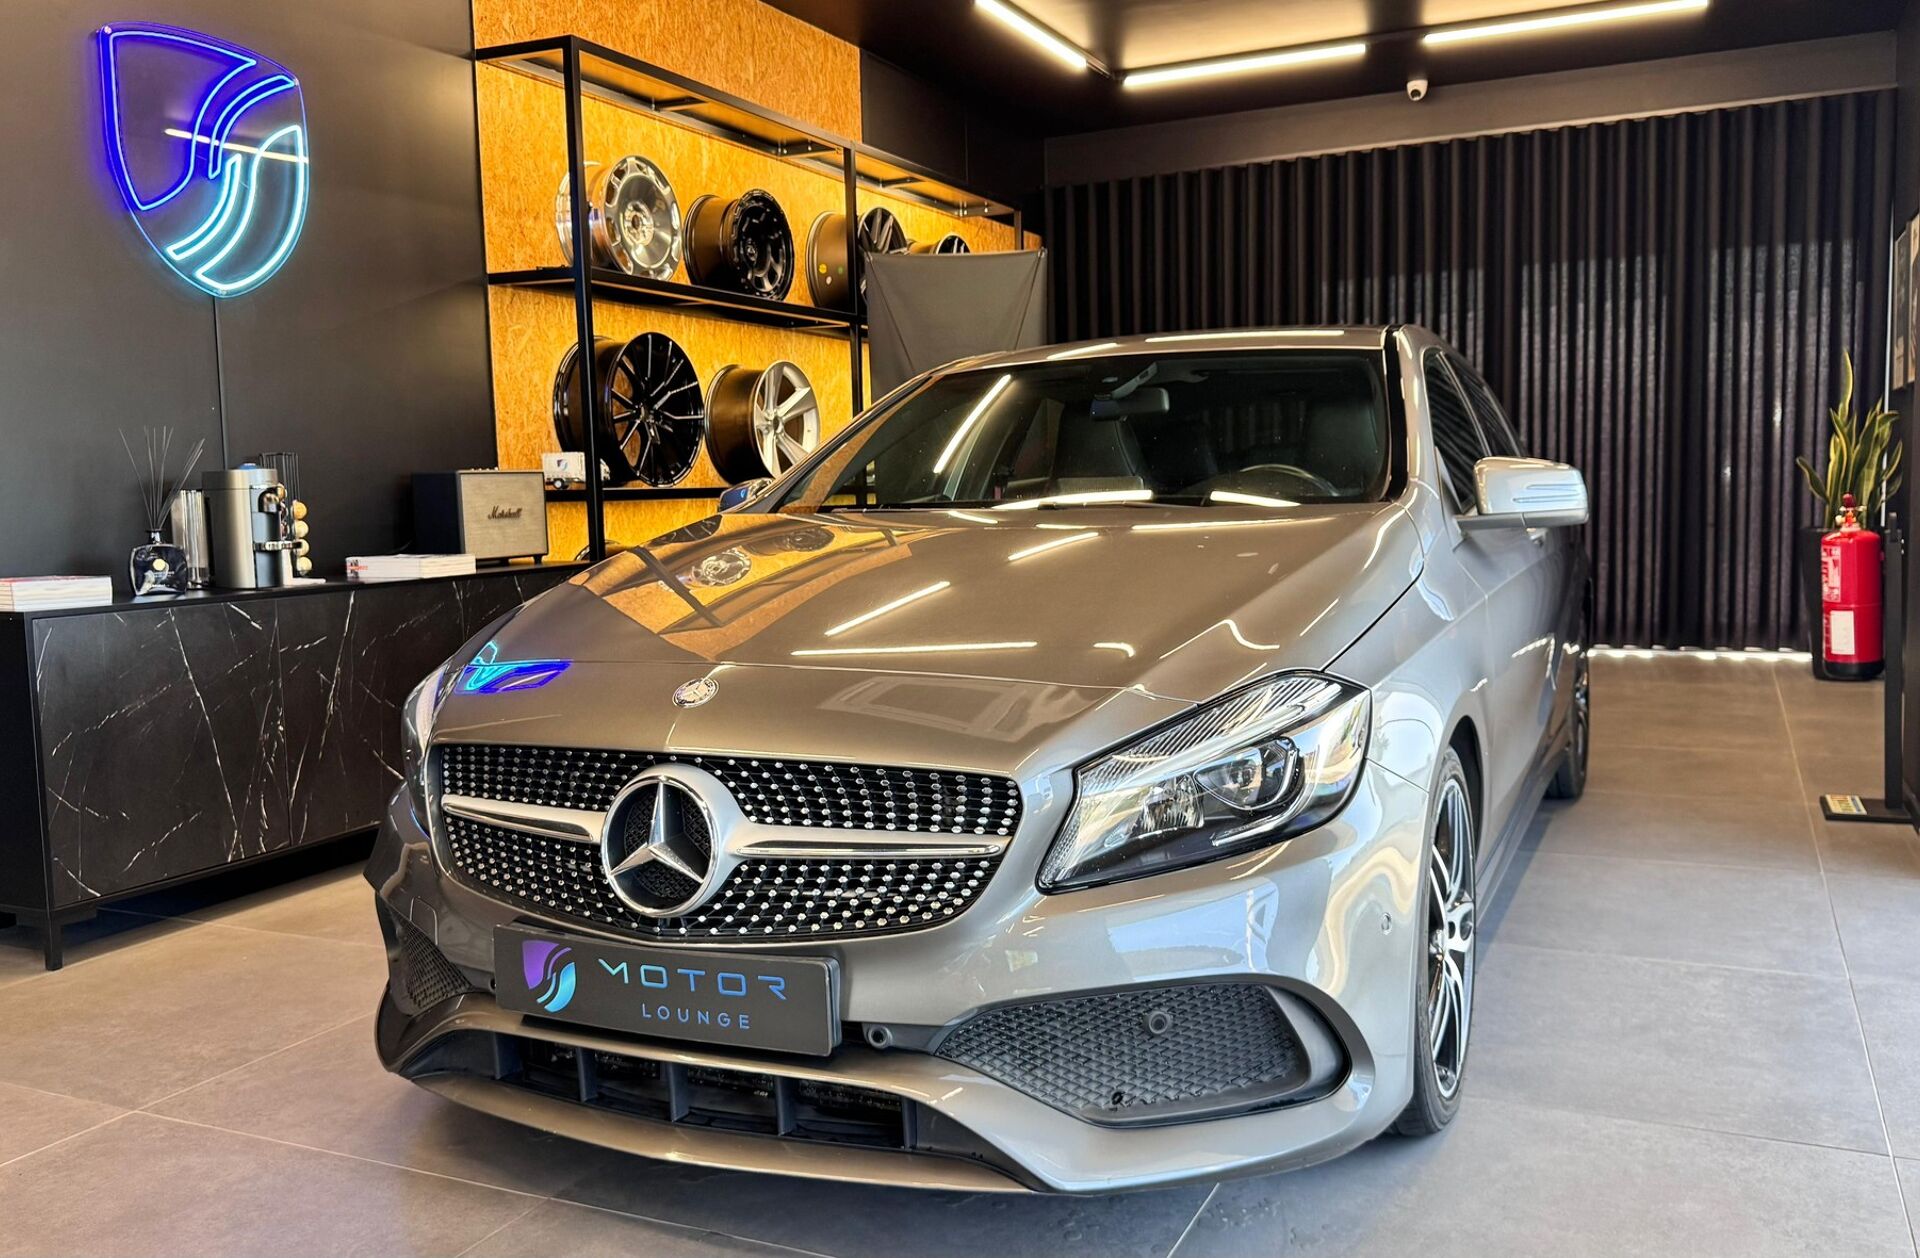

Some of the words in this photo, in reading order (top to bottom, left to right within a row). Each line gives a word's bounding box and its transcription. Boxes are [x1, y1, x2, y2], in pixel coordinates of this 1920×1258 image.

[487, 505, 523, 520] Marshall
[598, 958, 787, 1000] MOTOR
[642, 1003, 750, 1030] LOUNGE
